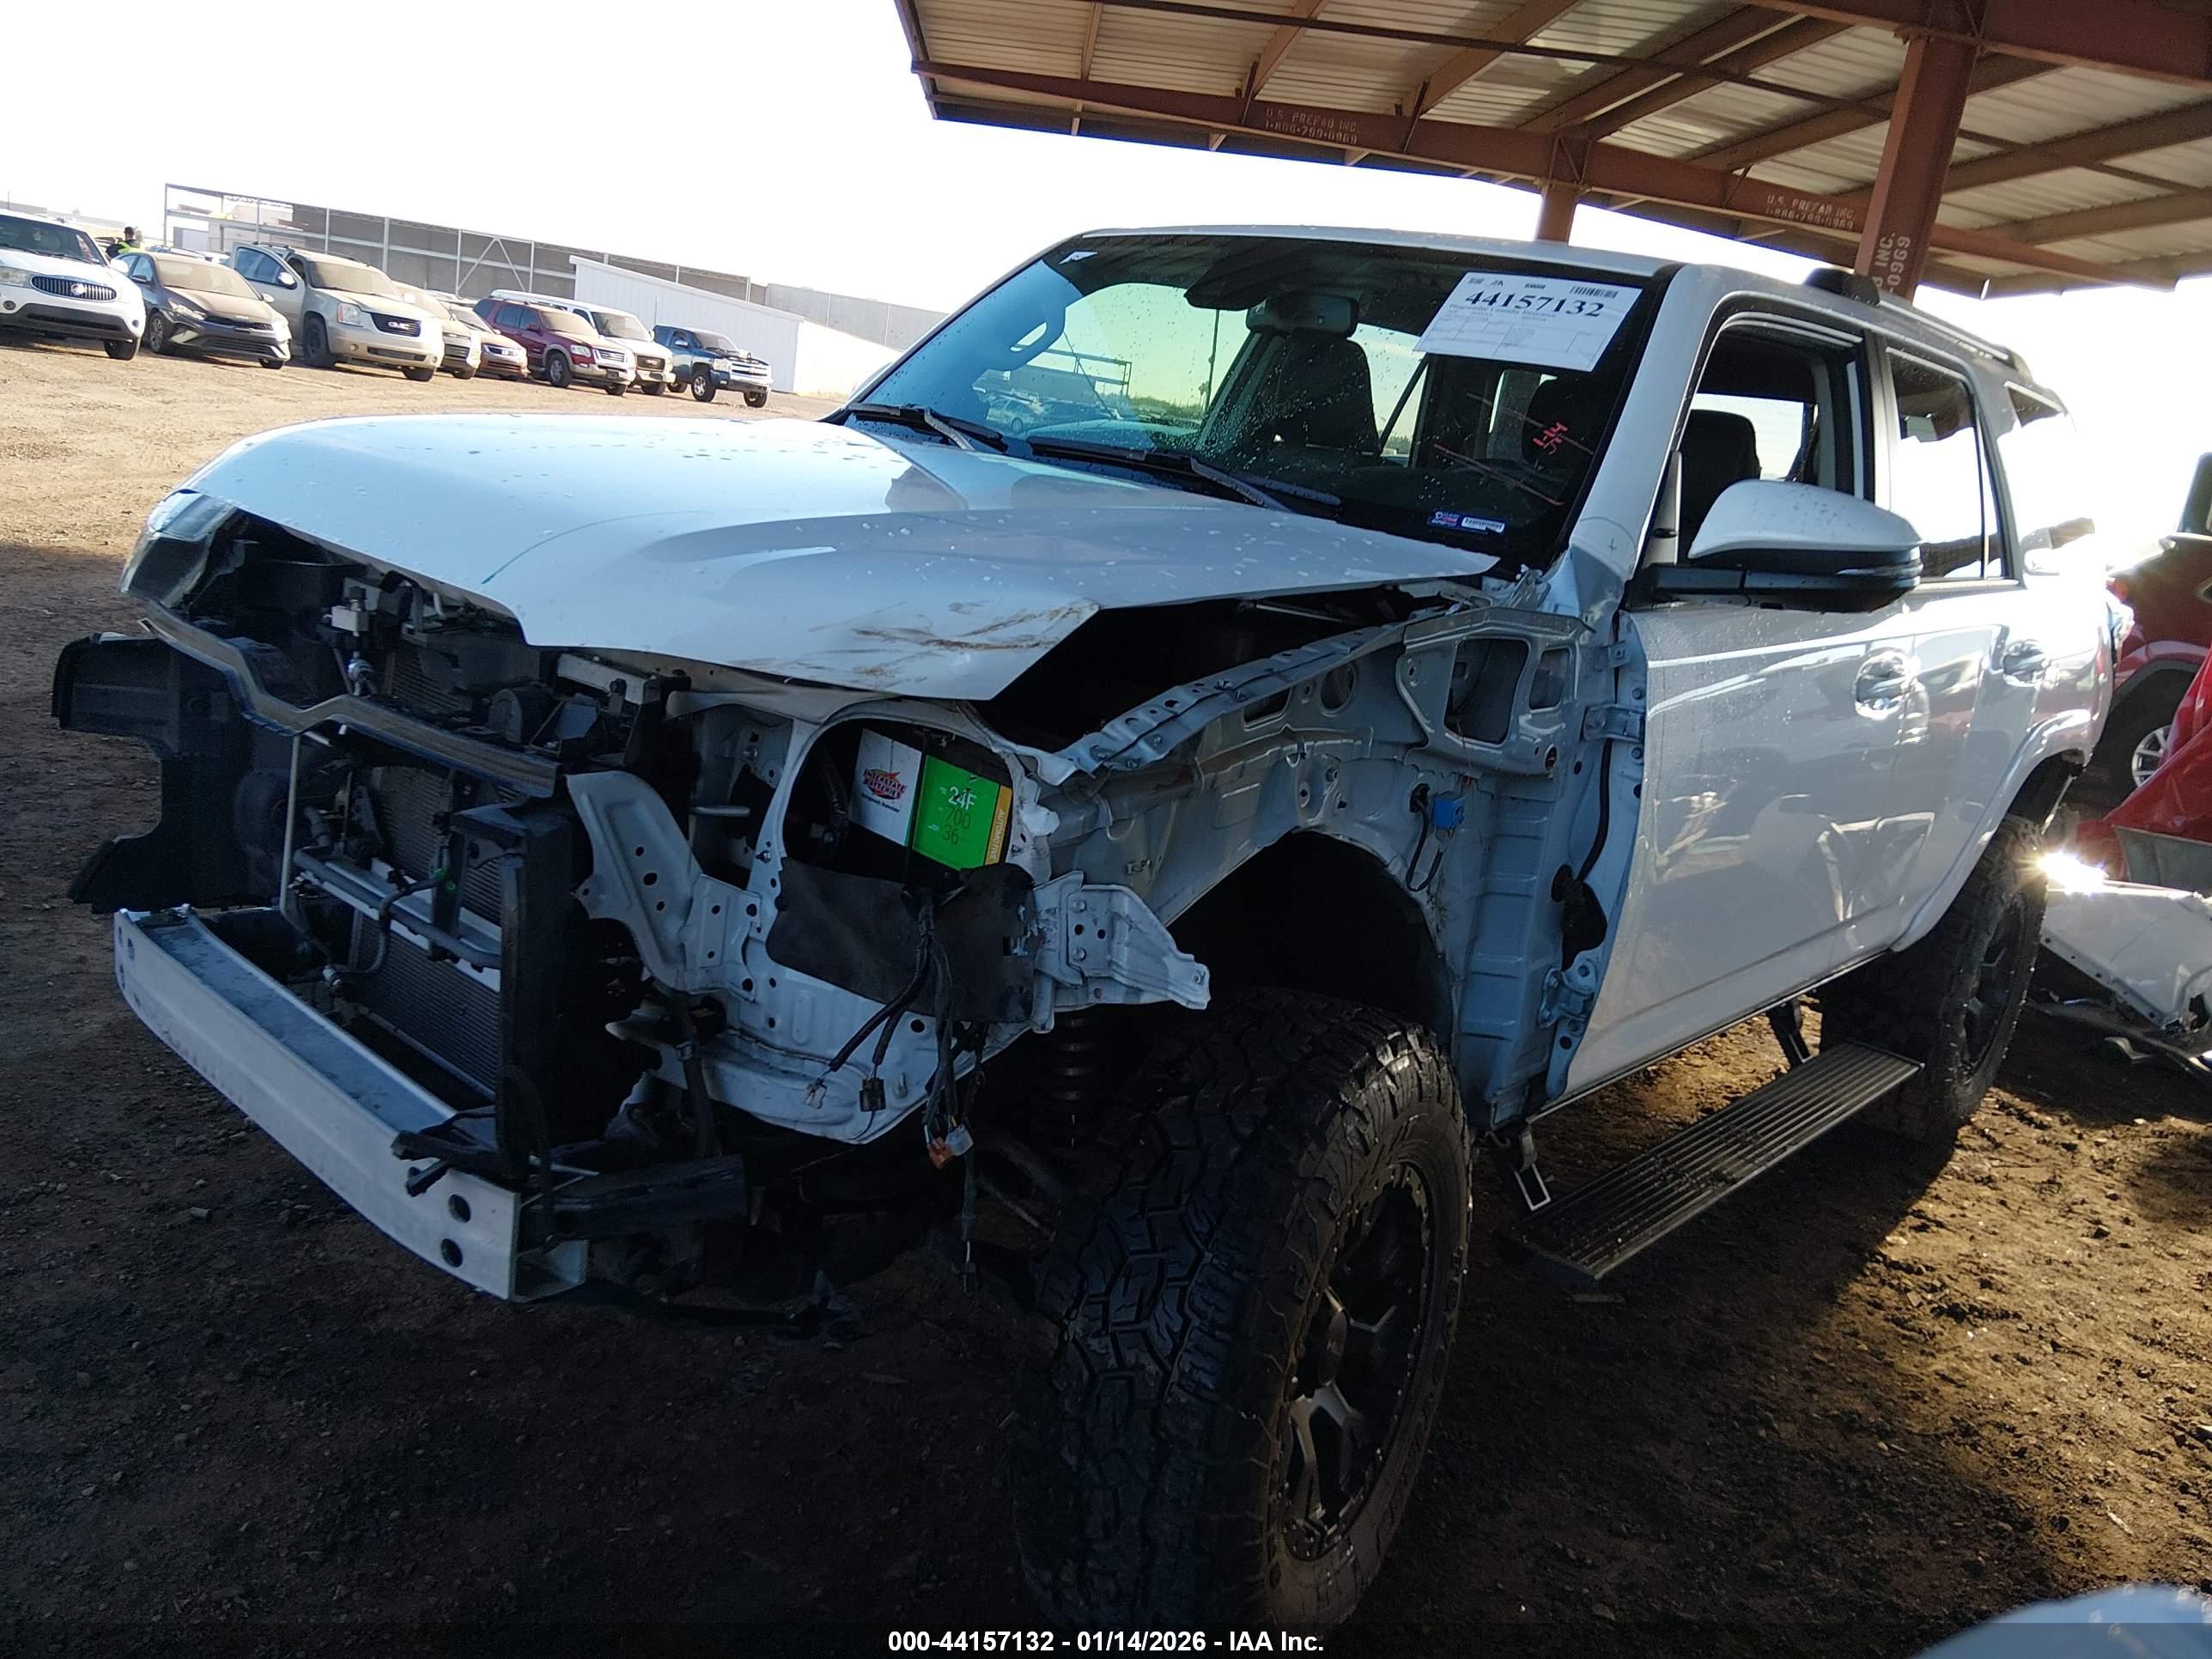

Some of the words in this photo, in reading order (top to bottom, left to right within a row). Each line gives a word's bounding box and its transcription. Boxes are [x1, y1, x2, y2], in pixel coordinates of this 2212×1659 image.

[1766, 194, 1786, 207] U.S.
[1792, 198, 1834, 216] PREFAB
[1835, 206, 1856, 221] INC.
[1874, 233, 1896, 268] INC.
[1464, 289, 1606, 318] 44157132
[863, 768, 908, 793] INTERSTATE
[863, 777, 902, 799] BATTERIES
[948, 786, 977, 811] 24F
[945, 805, 971, 830] 700
[941, 823, 960, 845] 36
[989, 809, 1006, 860] AUTOMOTIVE
